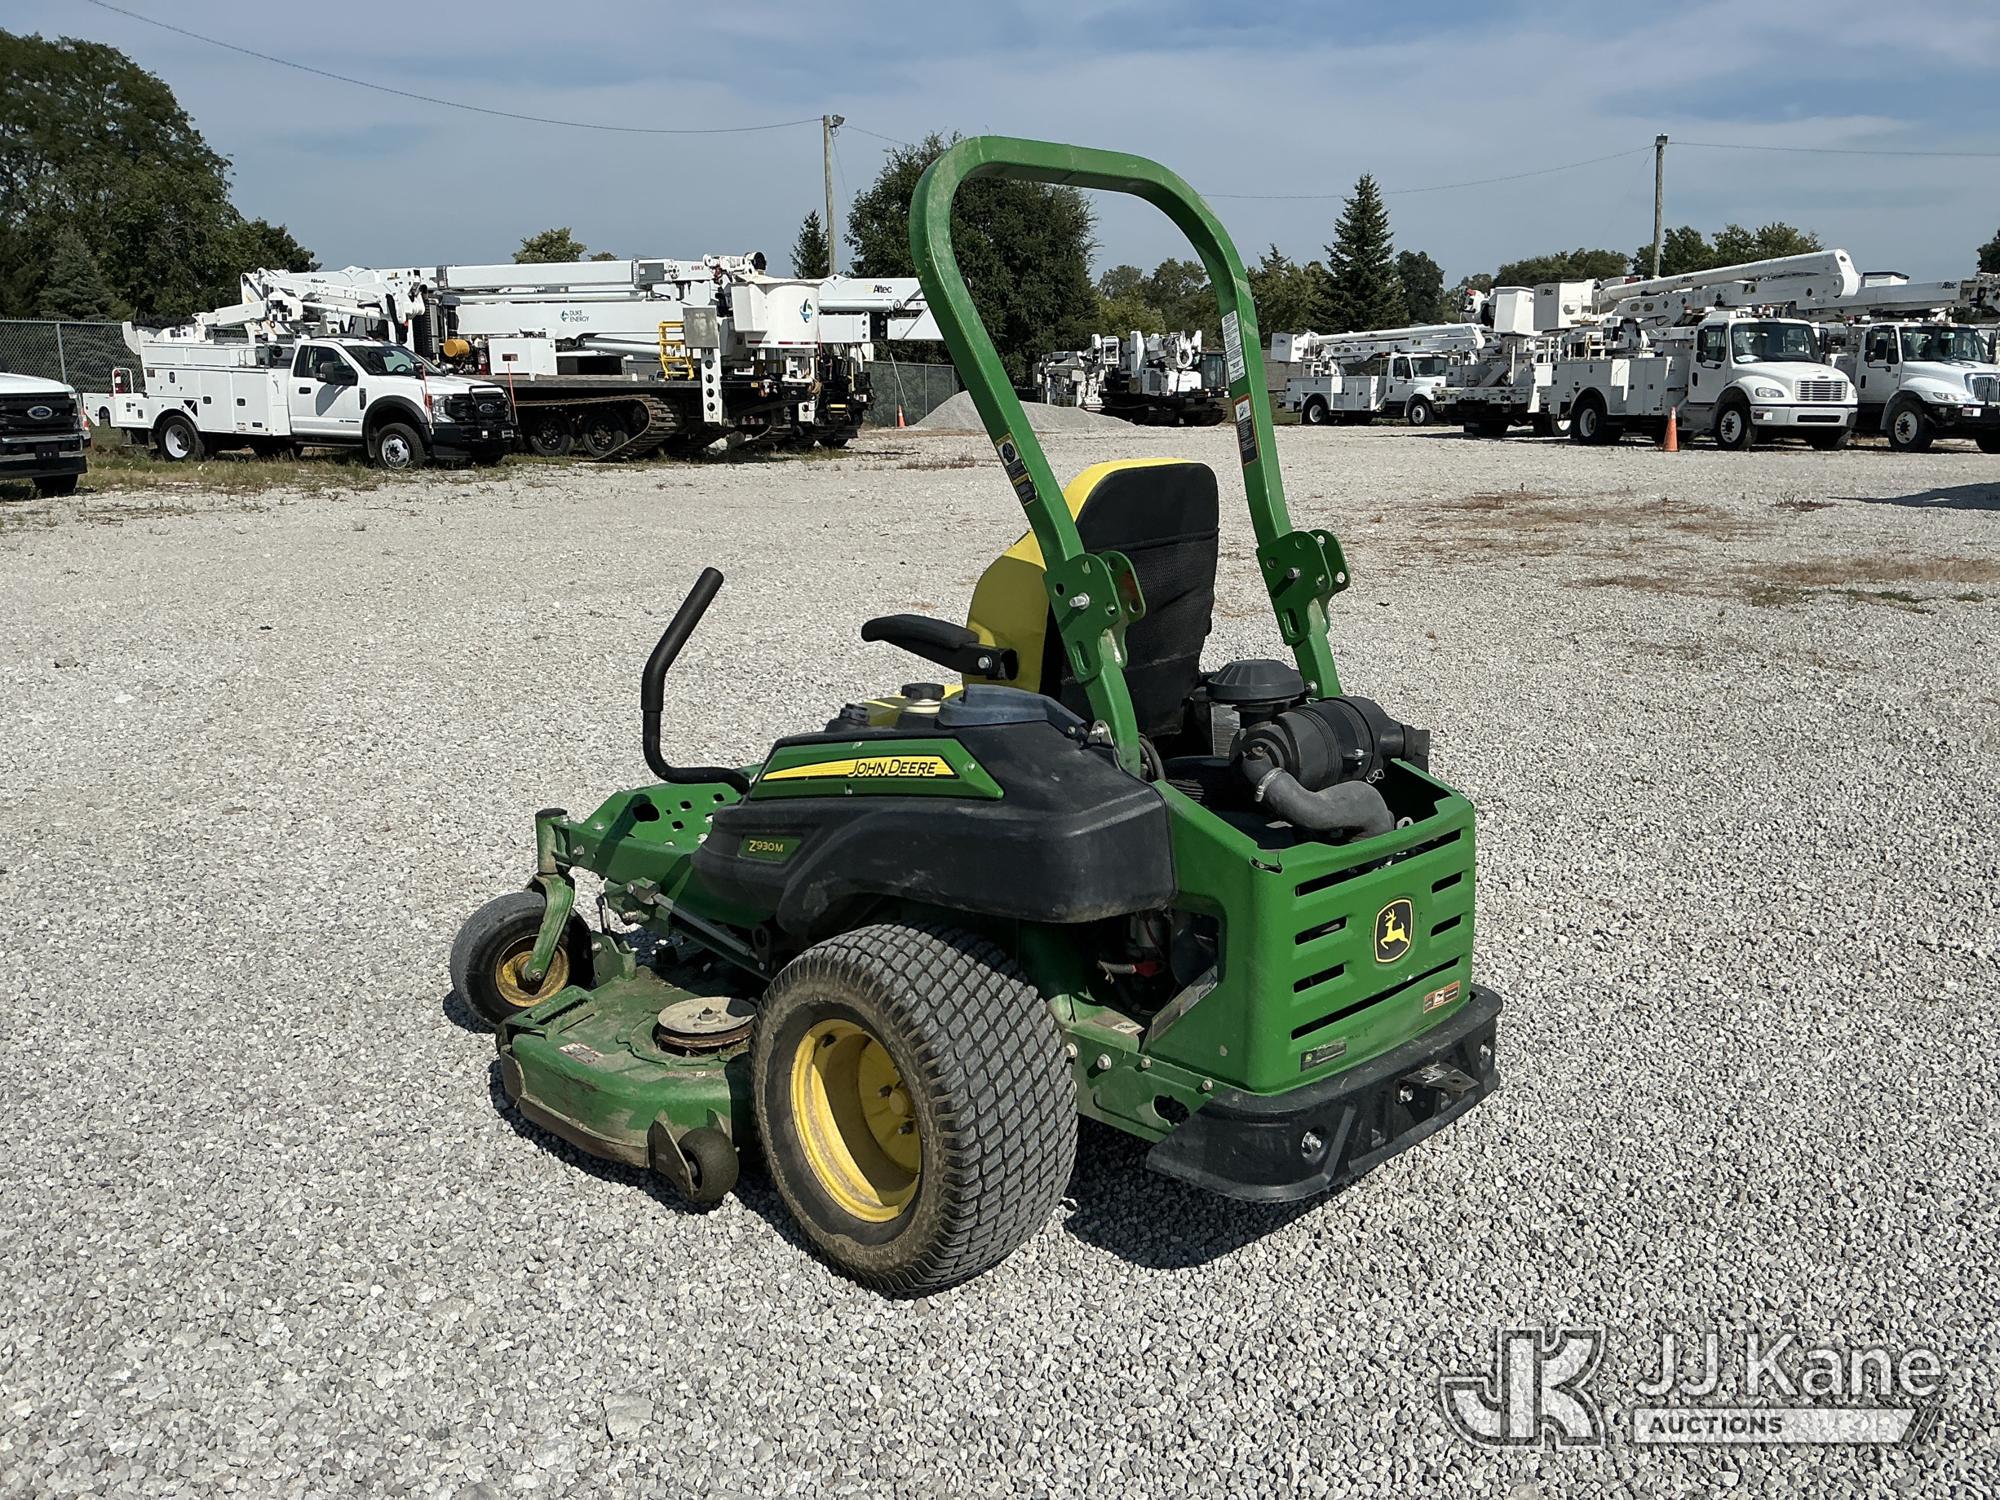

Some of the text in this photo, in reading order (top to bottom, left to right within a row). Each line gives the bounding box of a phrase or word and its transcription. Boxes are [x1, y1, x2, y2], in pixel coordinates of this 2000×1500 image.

[848, 759, 938, 775] JOHN DEERE
[748, 840, 784, 853] Z930M
